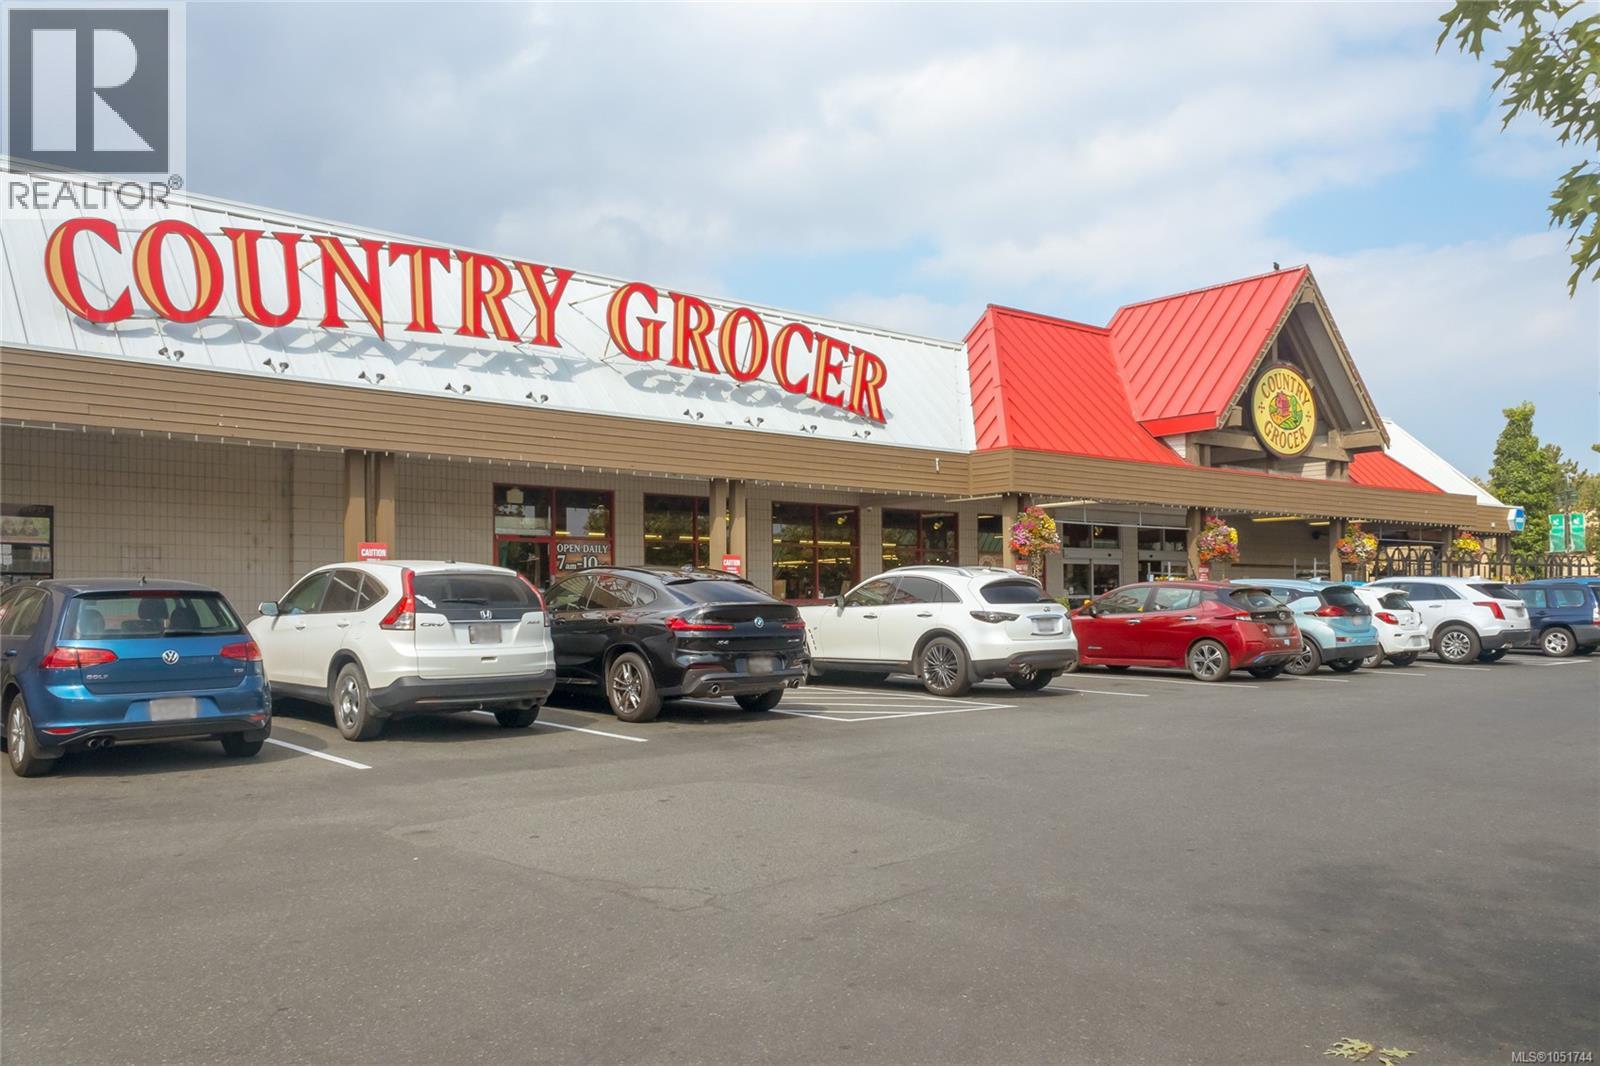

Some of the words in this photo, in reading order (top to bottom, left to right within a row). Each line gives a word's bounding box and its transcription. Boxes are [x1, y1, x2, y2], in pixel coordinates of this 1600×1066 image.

[45, 217, 575, 348] COUNTRY
[606, 281, 888, 425] GROCER
[1261, 373, 1310, 405] COUNTRY
[1264, 421, 1307, 449] GROCER
[360, 548, 387, 557] CAUTION
[556, 543, 580, 553] OPEN
[582, 544, 609, 554] DAILY
